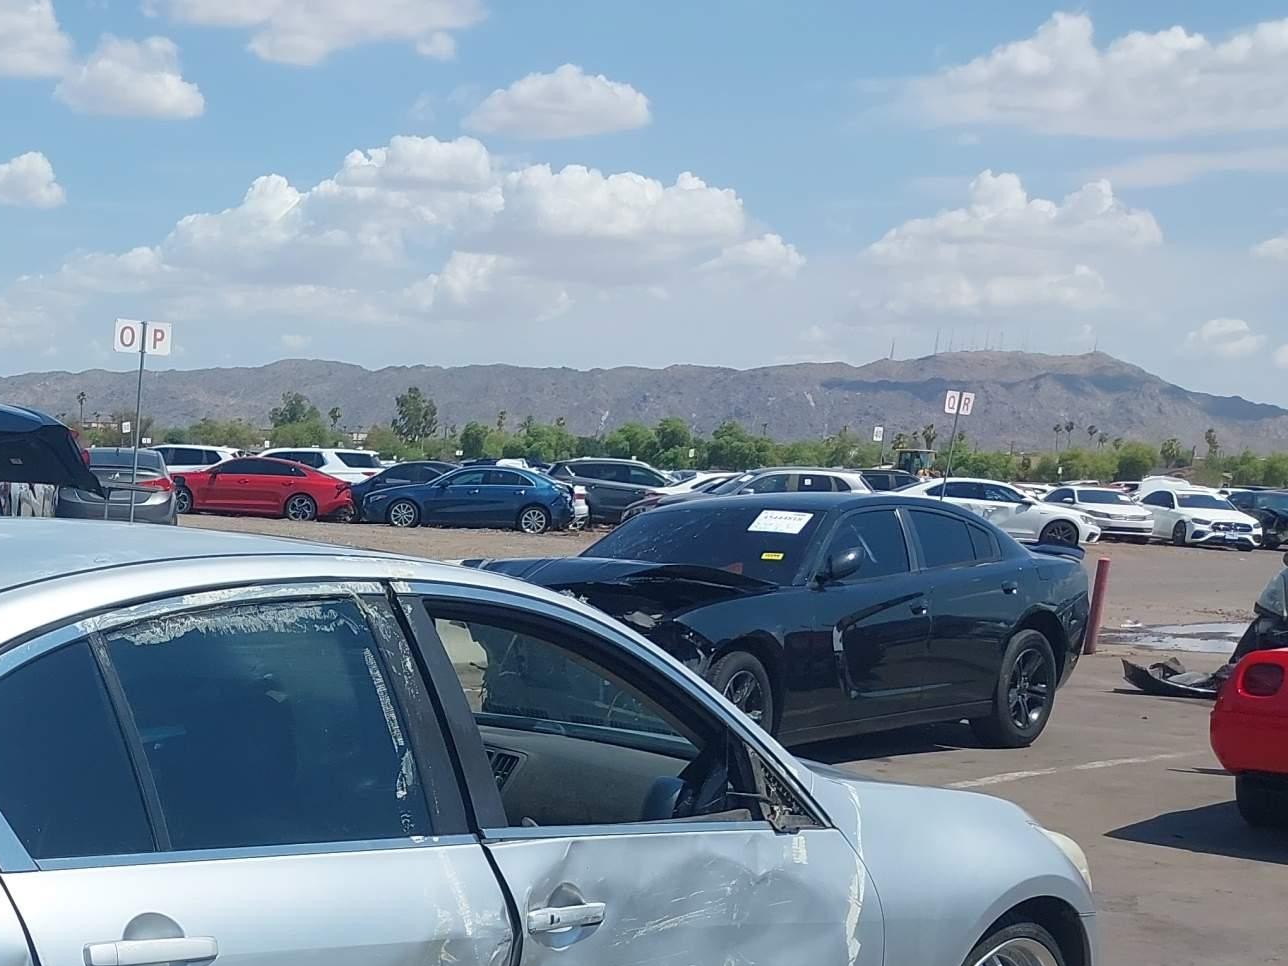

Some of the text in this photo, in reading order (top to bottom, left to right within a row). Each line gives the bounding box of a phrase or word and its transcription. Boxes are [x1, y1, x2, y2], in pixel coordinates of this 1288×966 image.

[119, 325, 136, 348] O
[152, 328, 165, 350] P
[947, 395, 956, 410] Q
[962, 397, 971, 412] R
